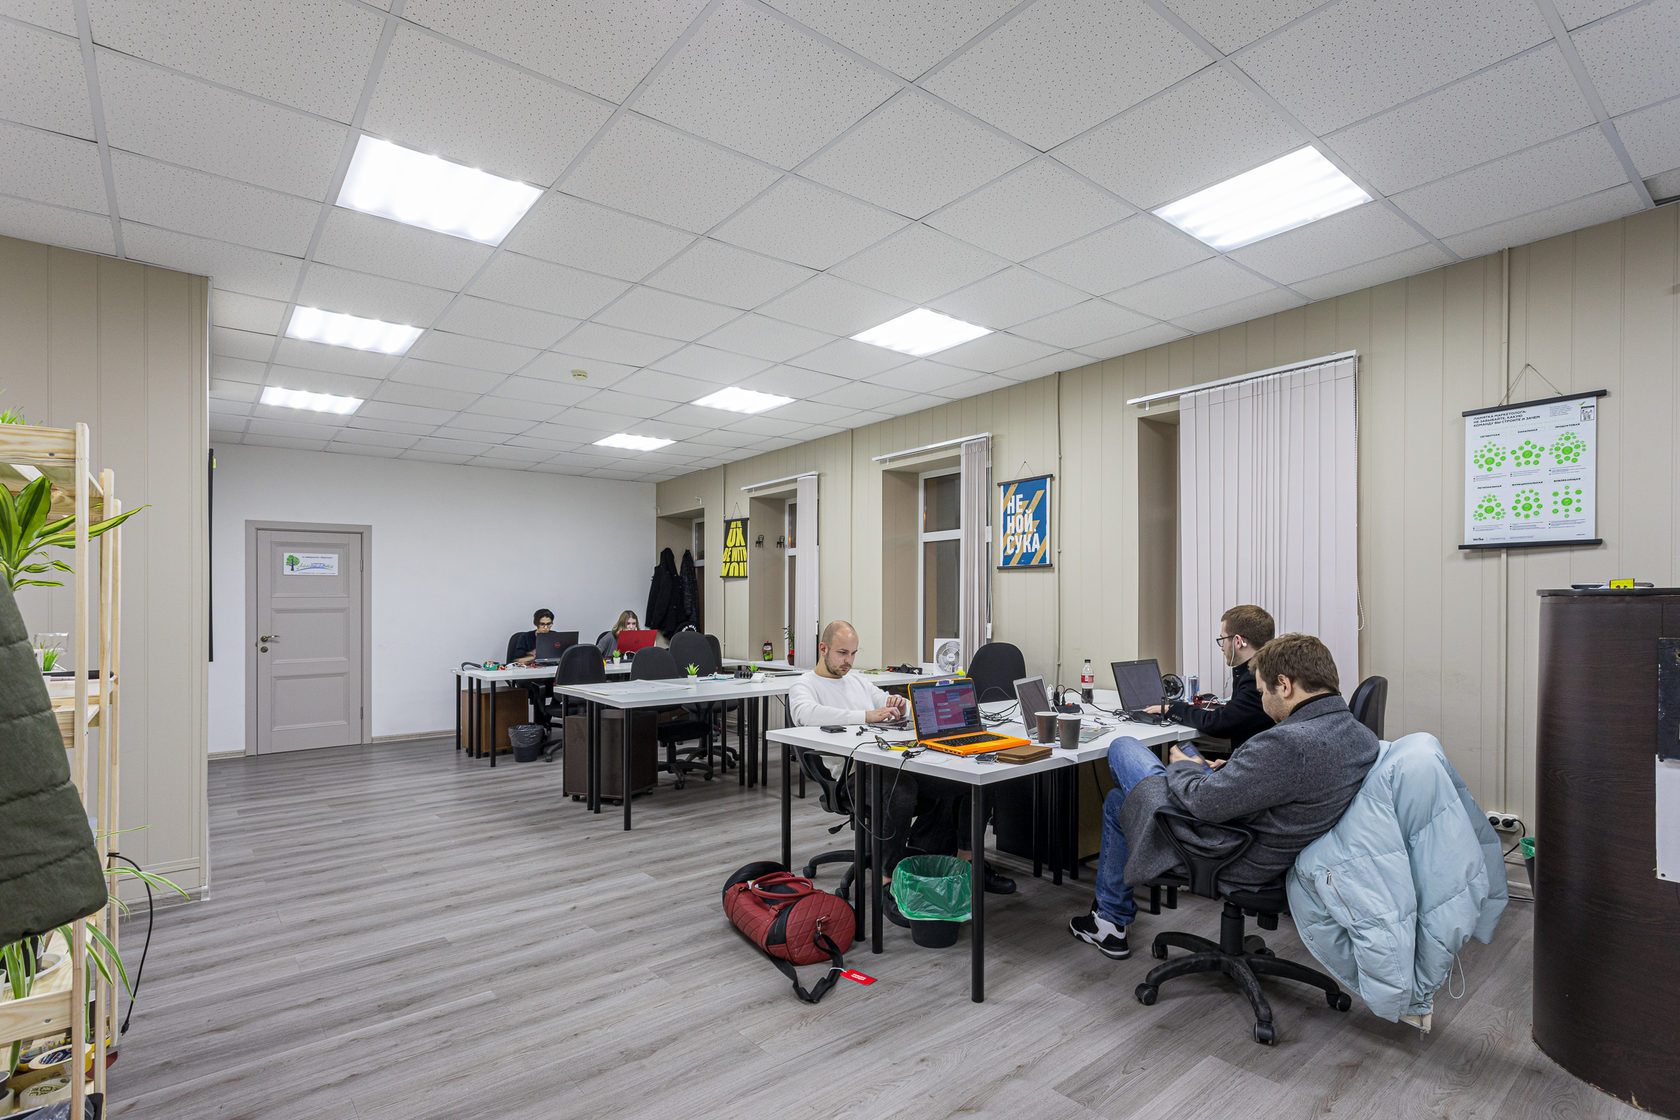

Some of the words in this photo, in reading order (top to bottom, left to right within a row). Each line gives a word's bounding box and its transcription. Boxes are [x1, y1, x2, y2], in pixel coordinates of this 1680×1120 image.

[1007, 494, 1023, 514] НЕ
[1007, 533, 1040, 554] СУКА
[723, 547, 731, 561] BE
